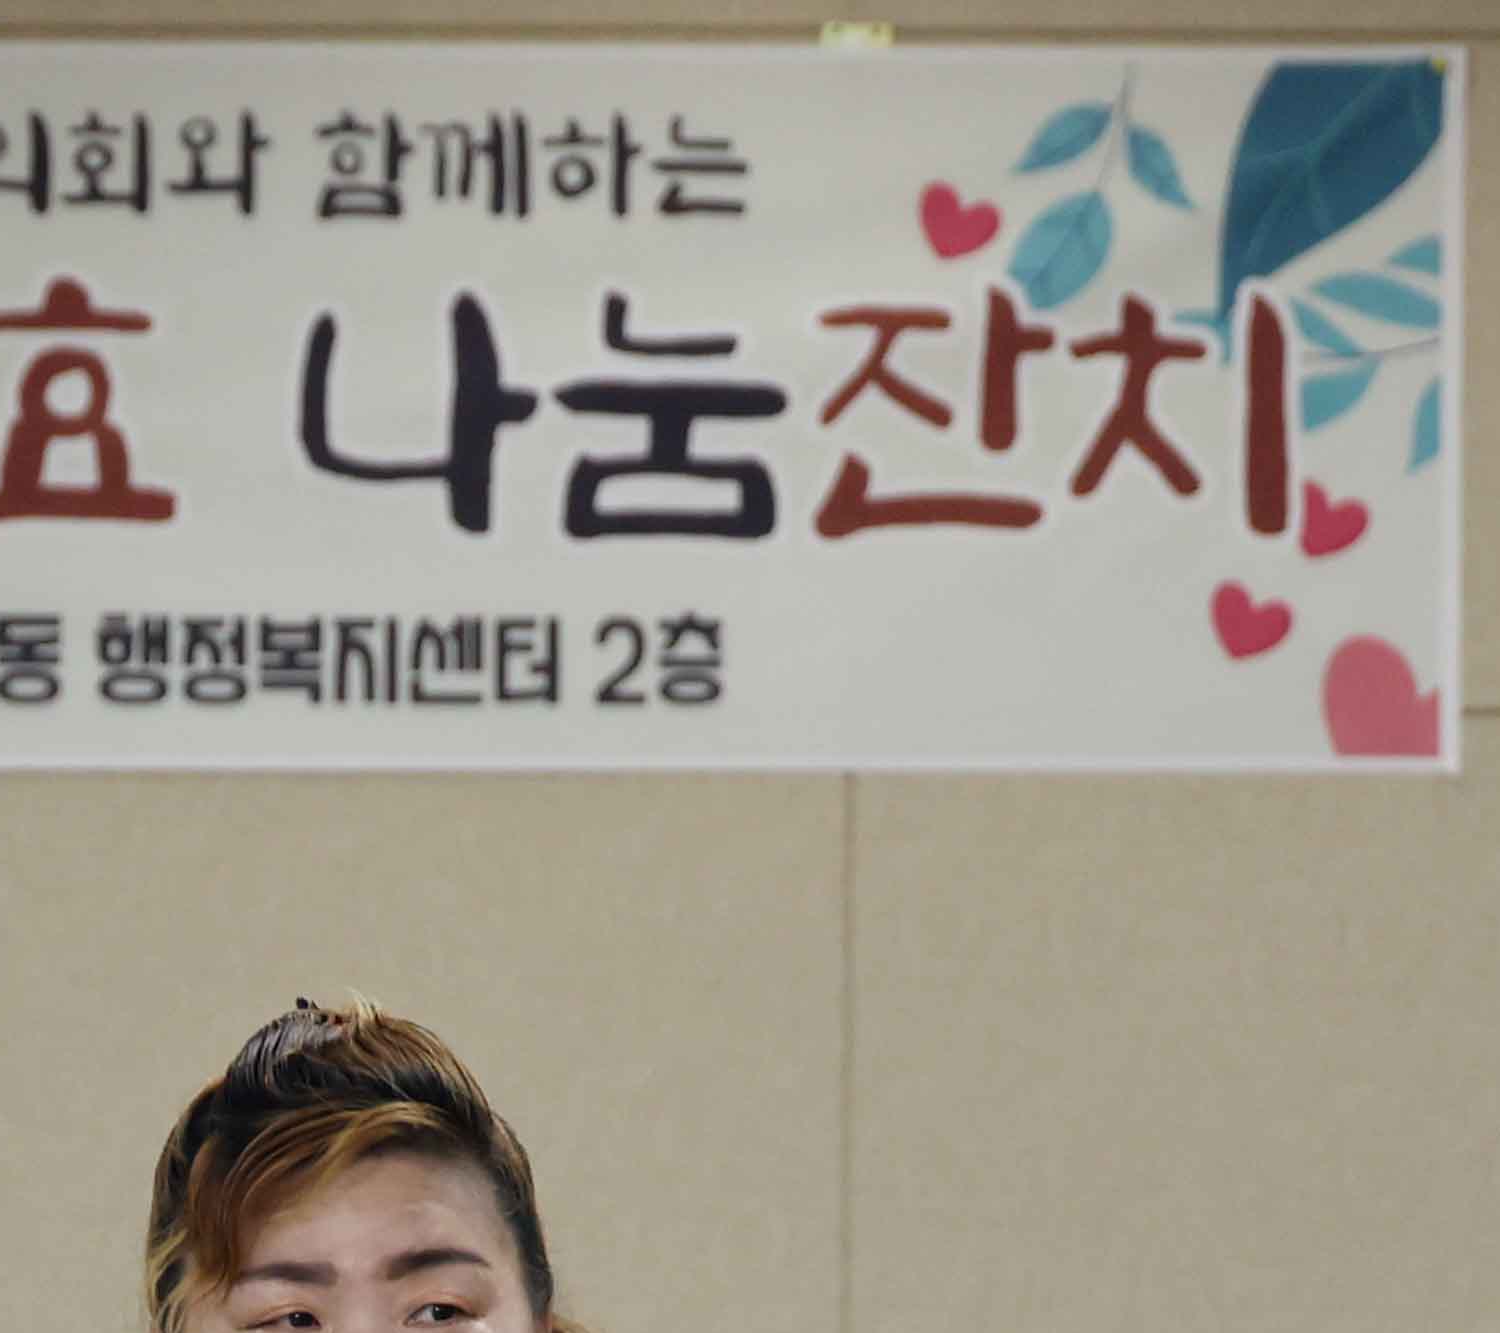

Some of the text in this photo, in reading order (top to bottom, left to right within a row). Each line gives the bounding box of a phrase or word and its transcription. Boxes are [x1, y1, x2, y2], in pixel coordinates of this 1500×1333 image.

[317, 115, 747, 219] 함께하는
[96, 615, 560, 704] 행정복지센터
[596, 615, 722, 704] 2층
